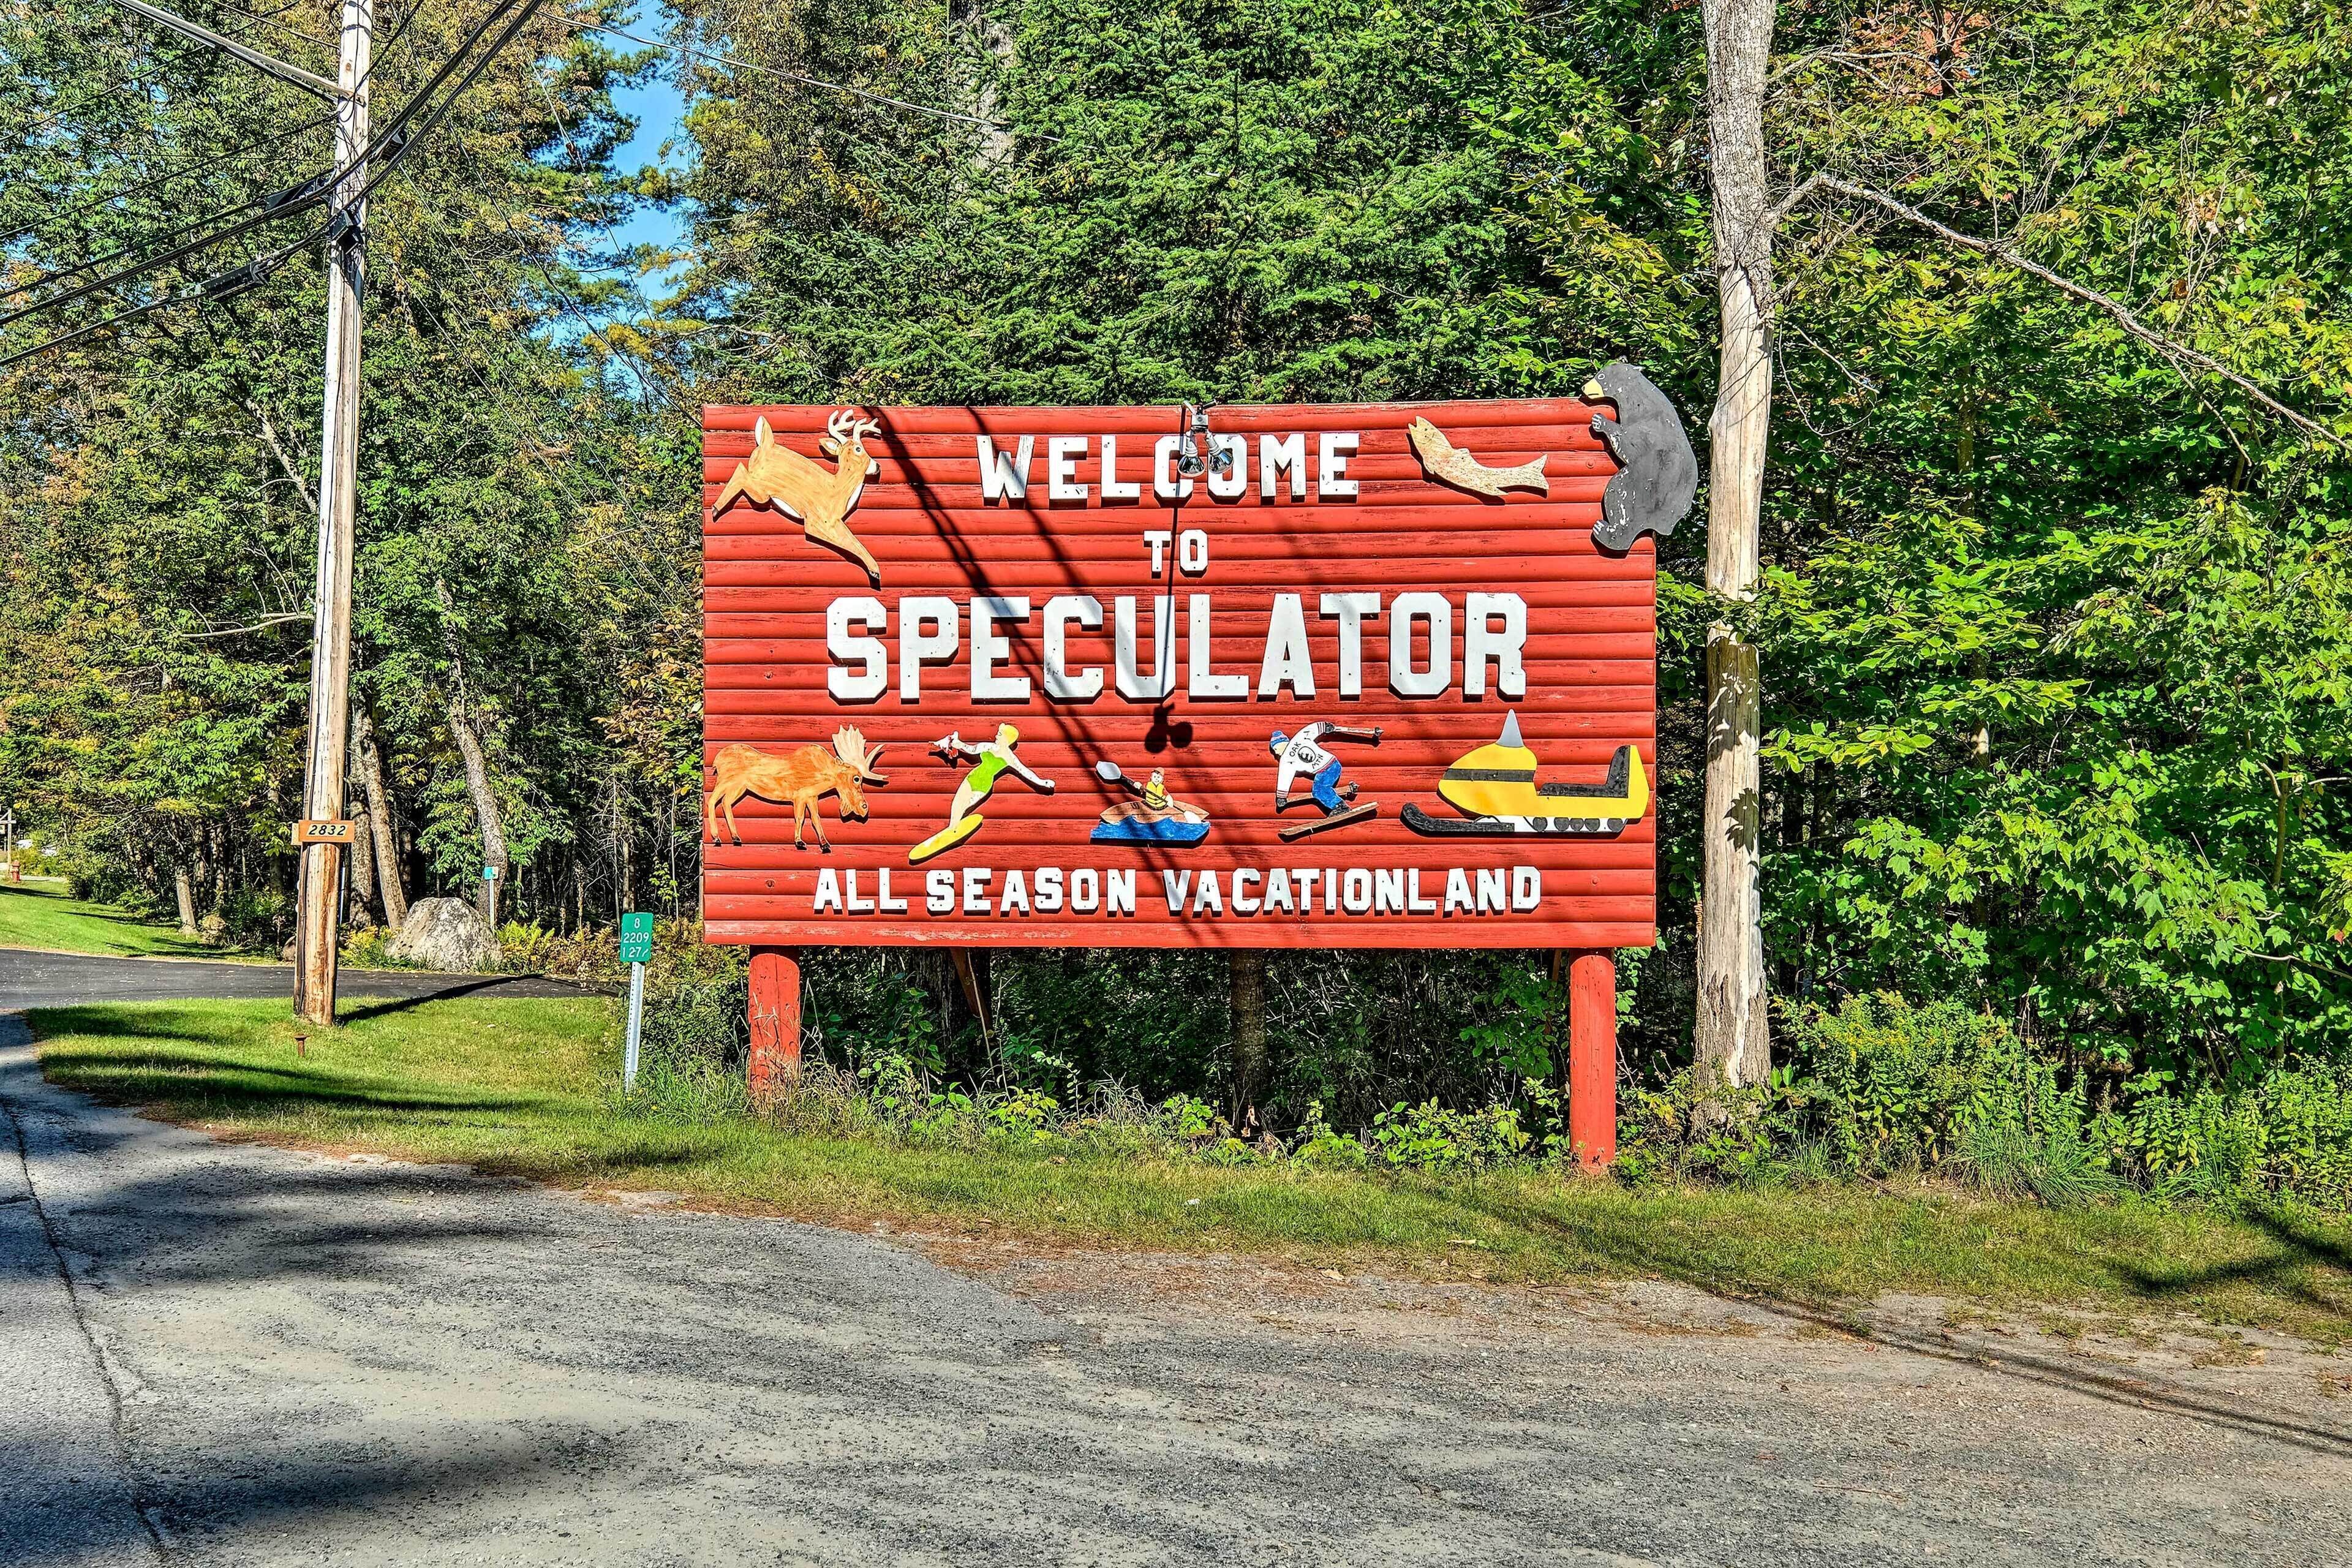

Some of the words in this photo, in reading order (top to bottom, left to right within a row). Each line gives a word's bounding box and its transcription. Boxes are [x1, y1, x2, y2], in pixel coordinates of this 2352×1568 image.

[976, 432, 1360, 499] WELCOME
[1144, 529, 1208, 571] TO
[826, 592, 1527, 700] SPECULATOR
[1289, 742, 1302, 757] OAK
[1311, 753, 1324, 769] MTN
[308, 824, 346, 835] 2832
[813, 867, 908, 911] ALL
[925, 867, 1136, 911] SEASON
[1163, 865, 1542, 912] VACATIONLAND
[634, 918, 641, 929] 8
[623, 932, 649, 943] 2209
